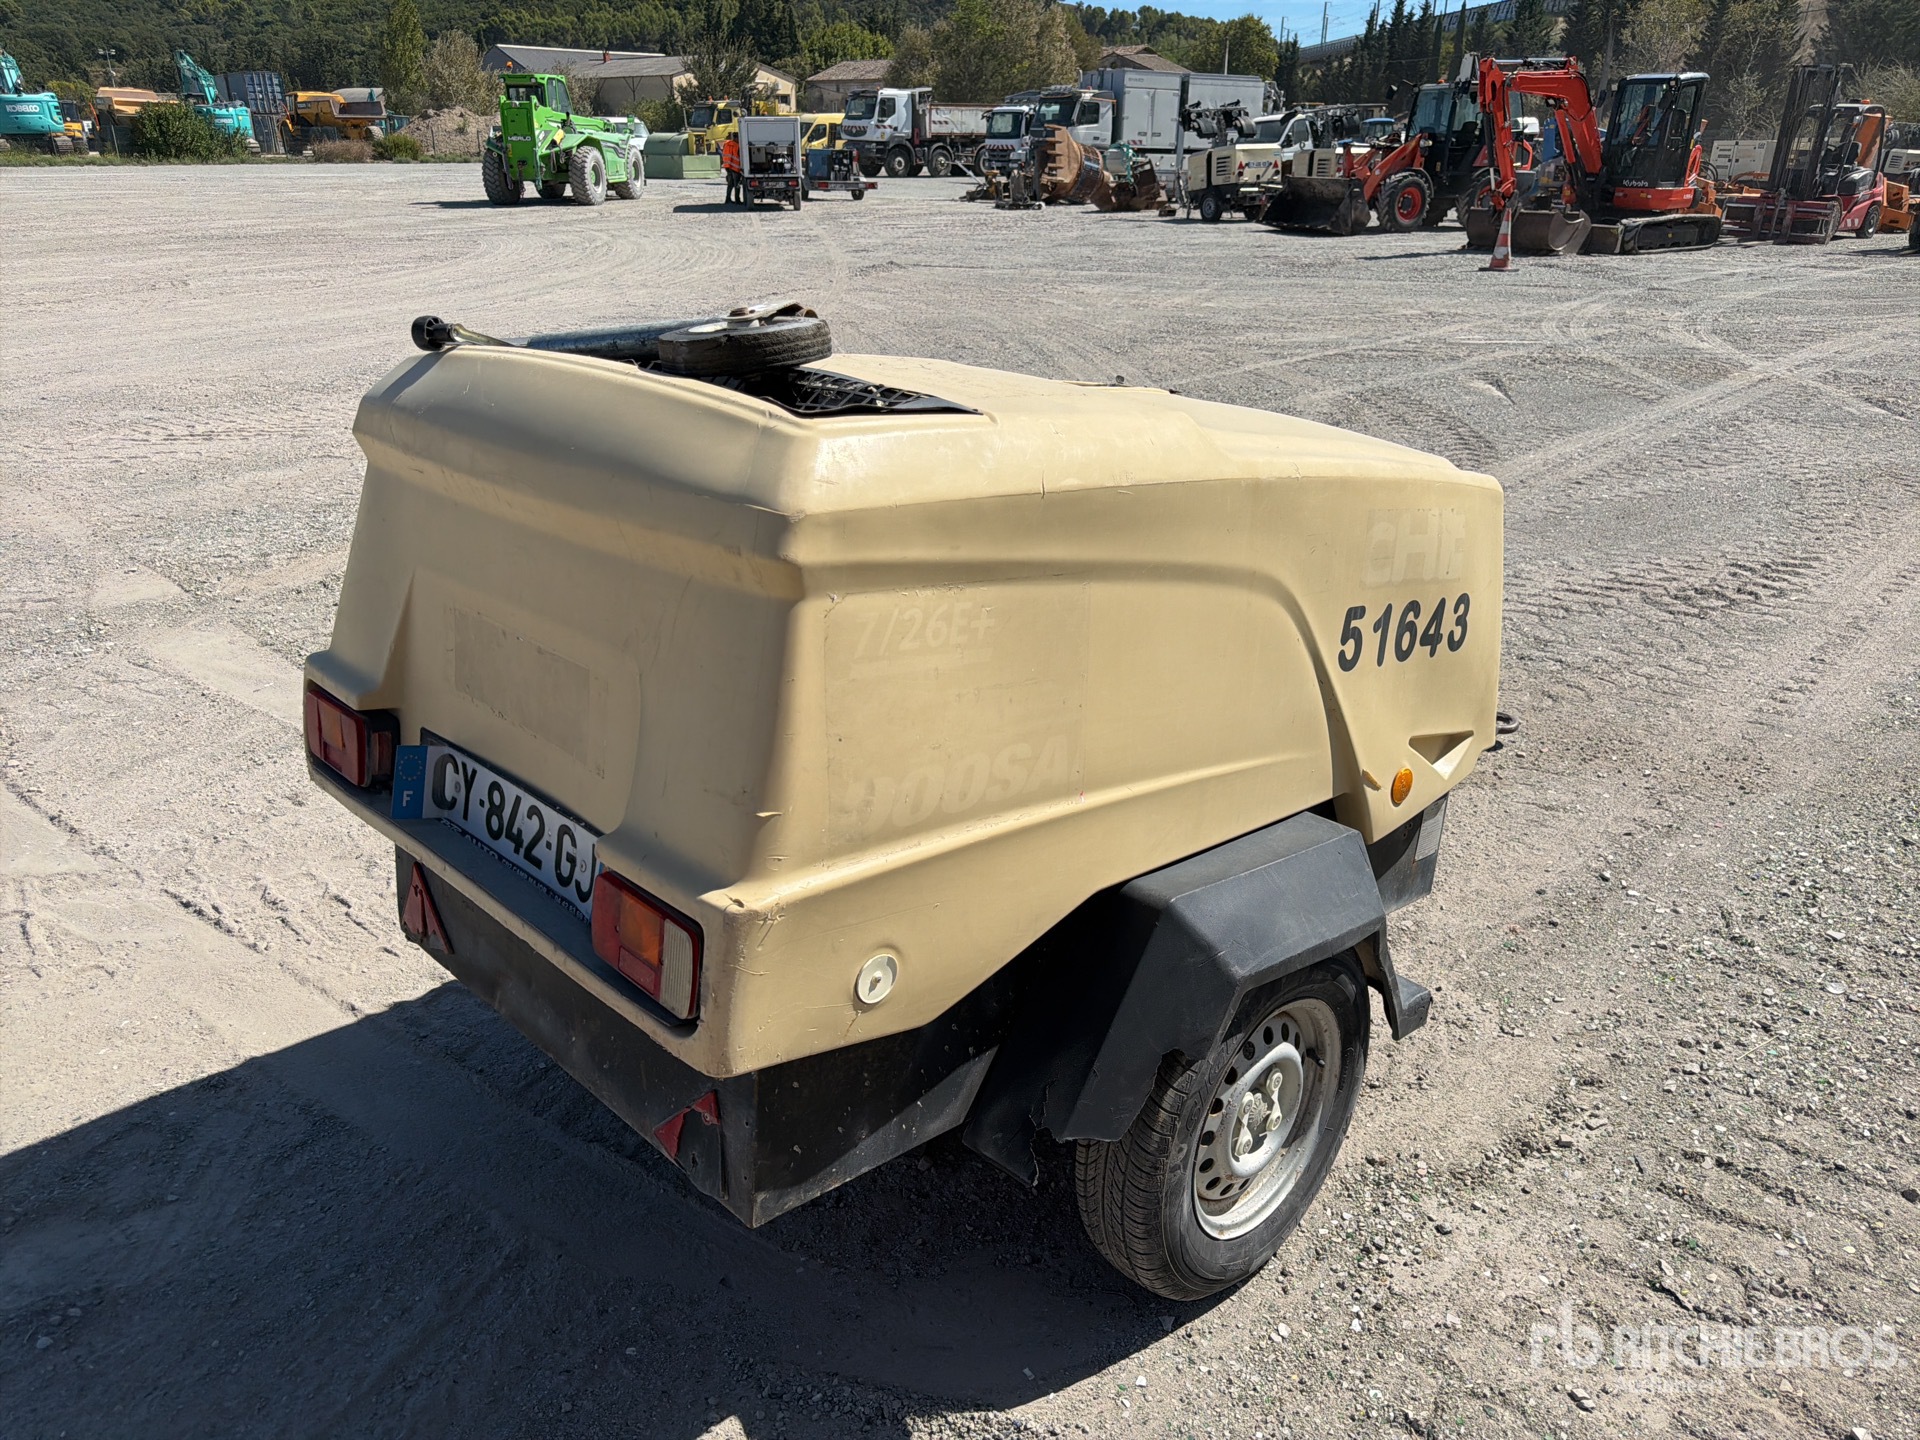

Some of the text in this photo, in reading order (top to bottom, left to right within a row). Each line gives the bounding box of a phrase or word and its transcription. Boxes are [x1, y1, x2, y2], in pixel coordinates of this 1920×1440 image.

[5, 104, 40, 113] KOBELCO
[1622, 179, 1649, 187] Kubota
[854, 602, 996, 659] 7/26E+
[1338, 592, 1470, 672] 51643
[402, 790, 413, 807] F
